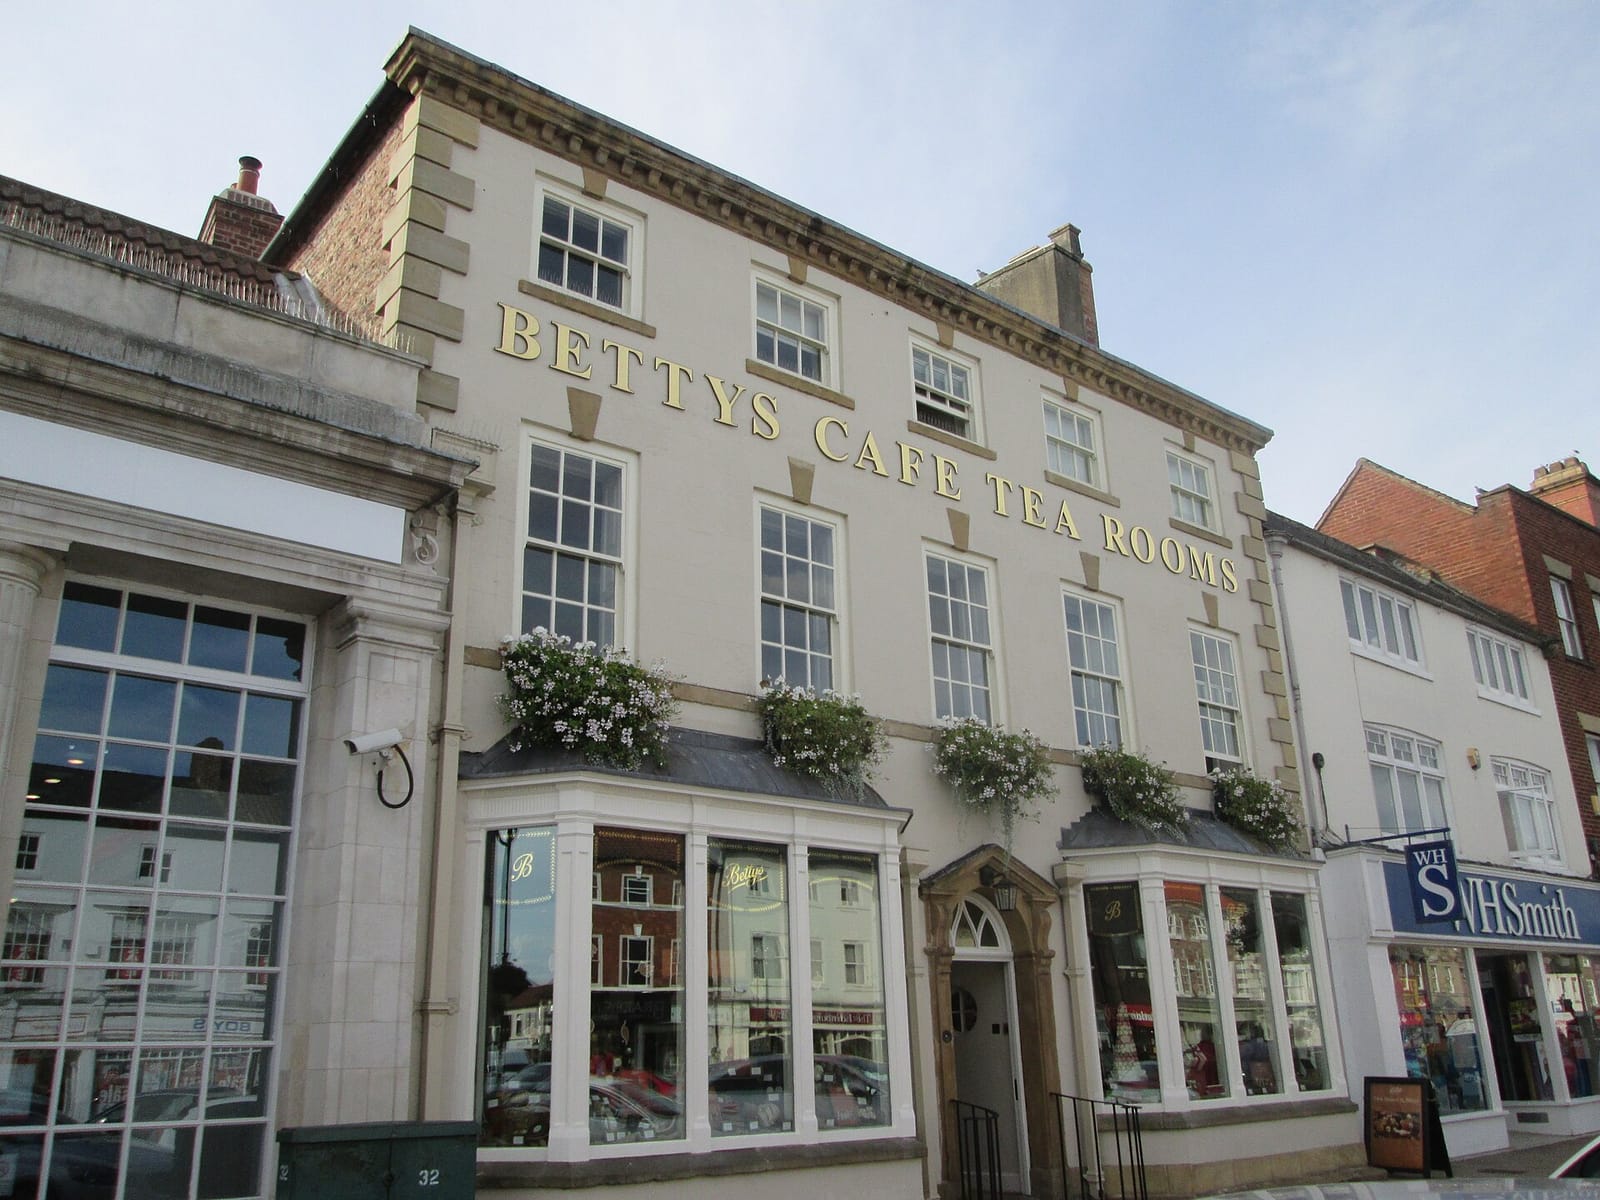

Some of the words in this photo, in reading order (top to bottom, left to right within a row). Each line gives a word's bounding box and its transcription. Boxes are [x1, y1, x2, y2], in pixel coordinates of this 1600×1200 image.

[494, 301, 780, 440] BETTYS
[814, 415, 962, 501] CAFE
[985, 472, 1082, 541] TEA
[1101, 512, 1240, 594] ROOMS
[511, 853, 534, 882] B
[1413, 848, 1448, 866] WH
[722, 862, 768, 894] Bettys
[1418, 864, 1455, 917] S
[1104, 900, 1121, 921] B
[1454, 877, 1582, 940] WHSmith
[418, 1168, 440, 1186] 32
